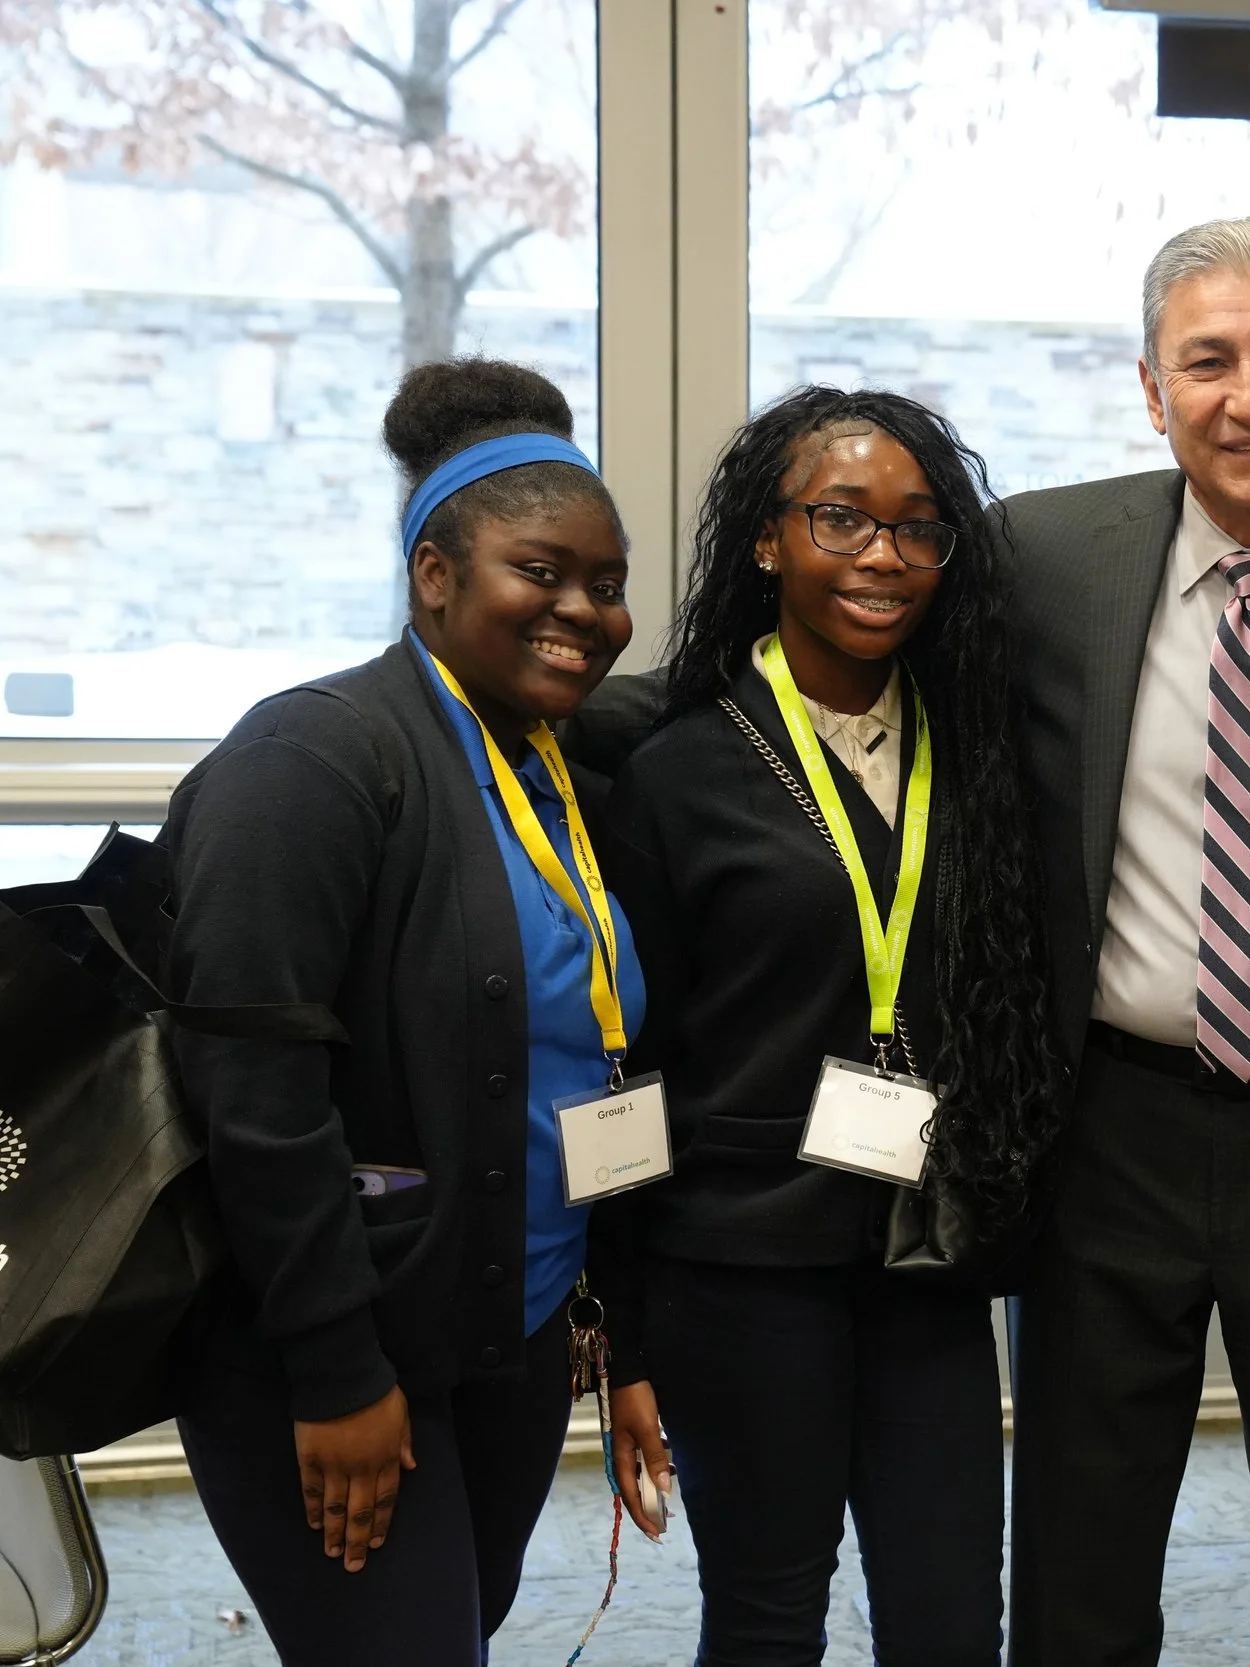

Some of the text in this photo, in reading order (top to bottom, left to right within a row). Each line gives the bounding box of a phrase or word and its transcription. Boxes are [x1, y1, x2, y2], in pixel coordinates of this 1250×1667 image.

[859, 1082, 901, 1101] Group 5
[597, 1102, 634, 1120] Group 1
